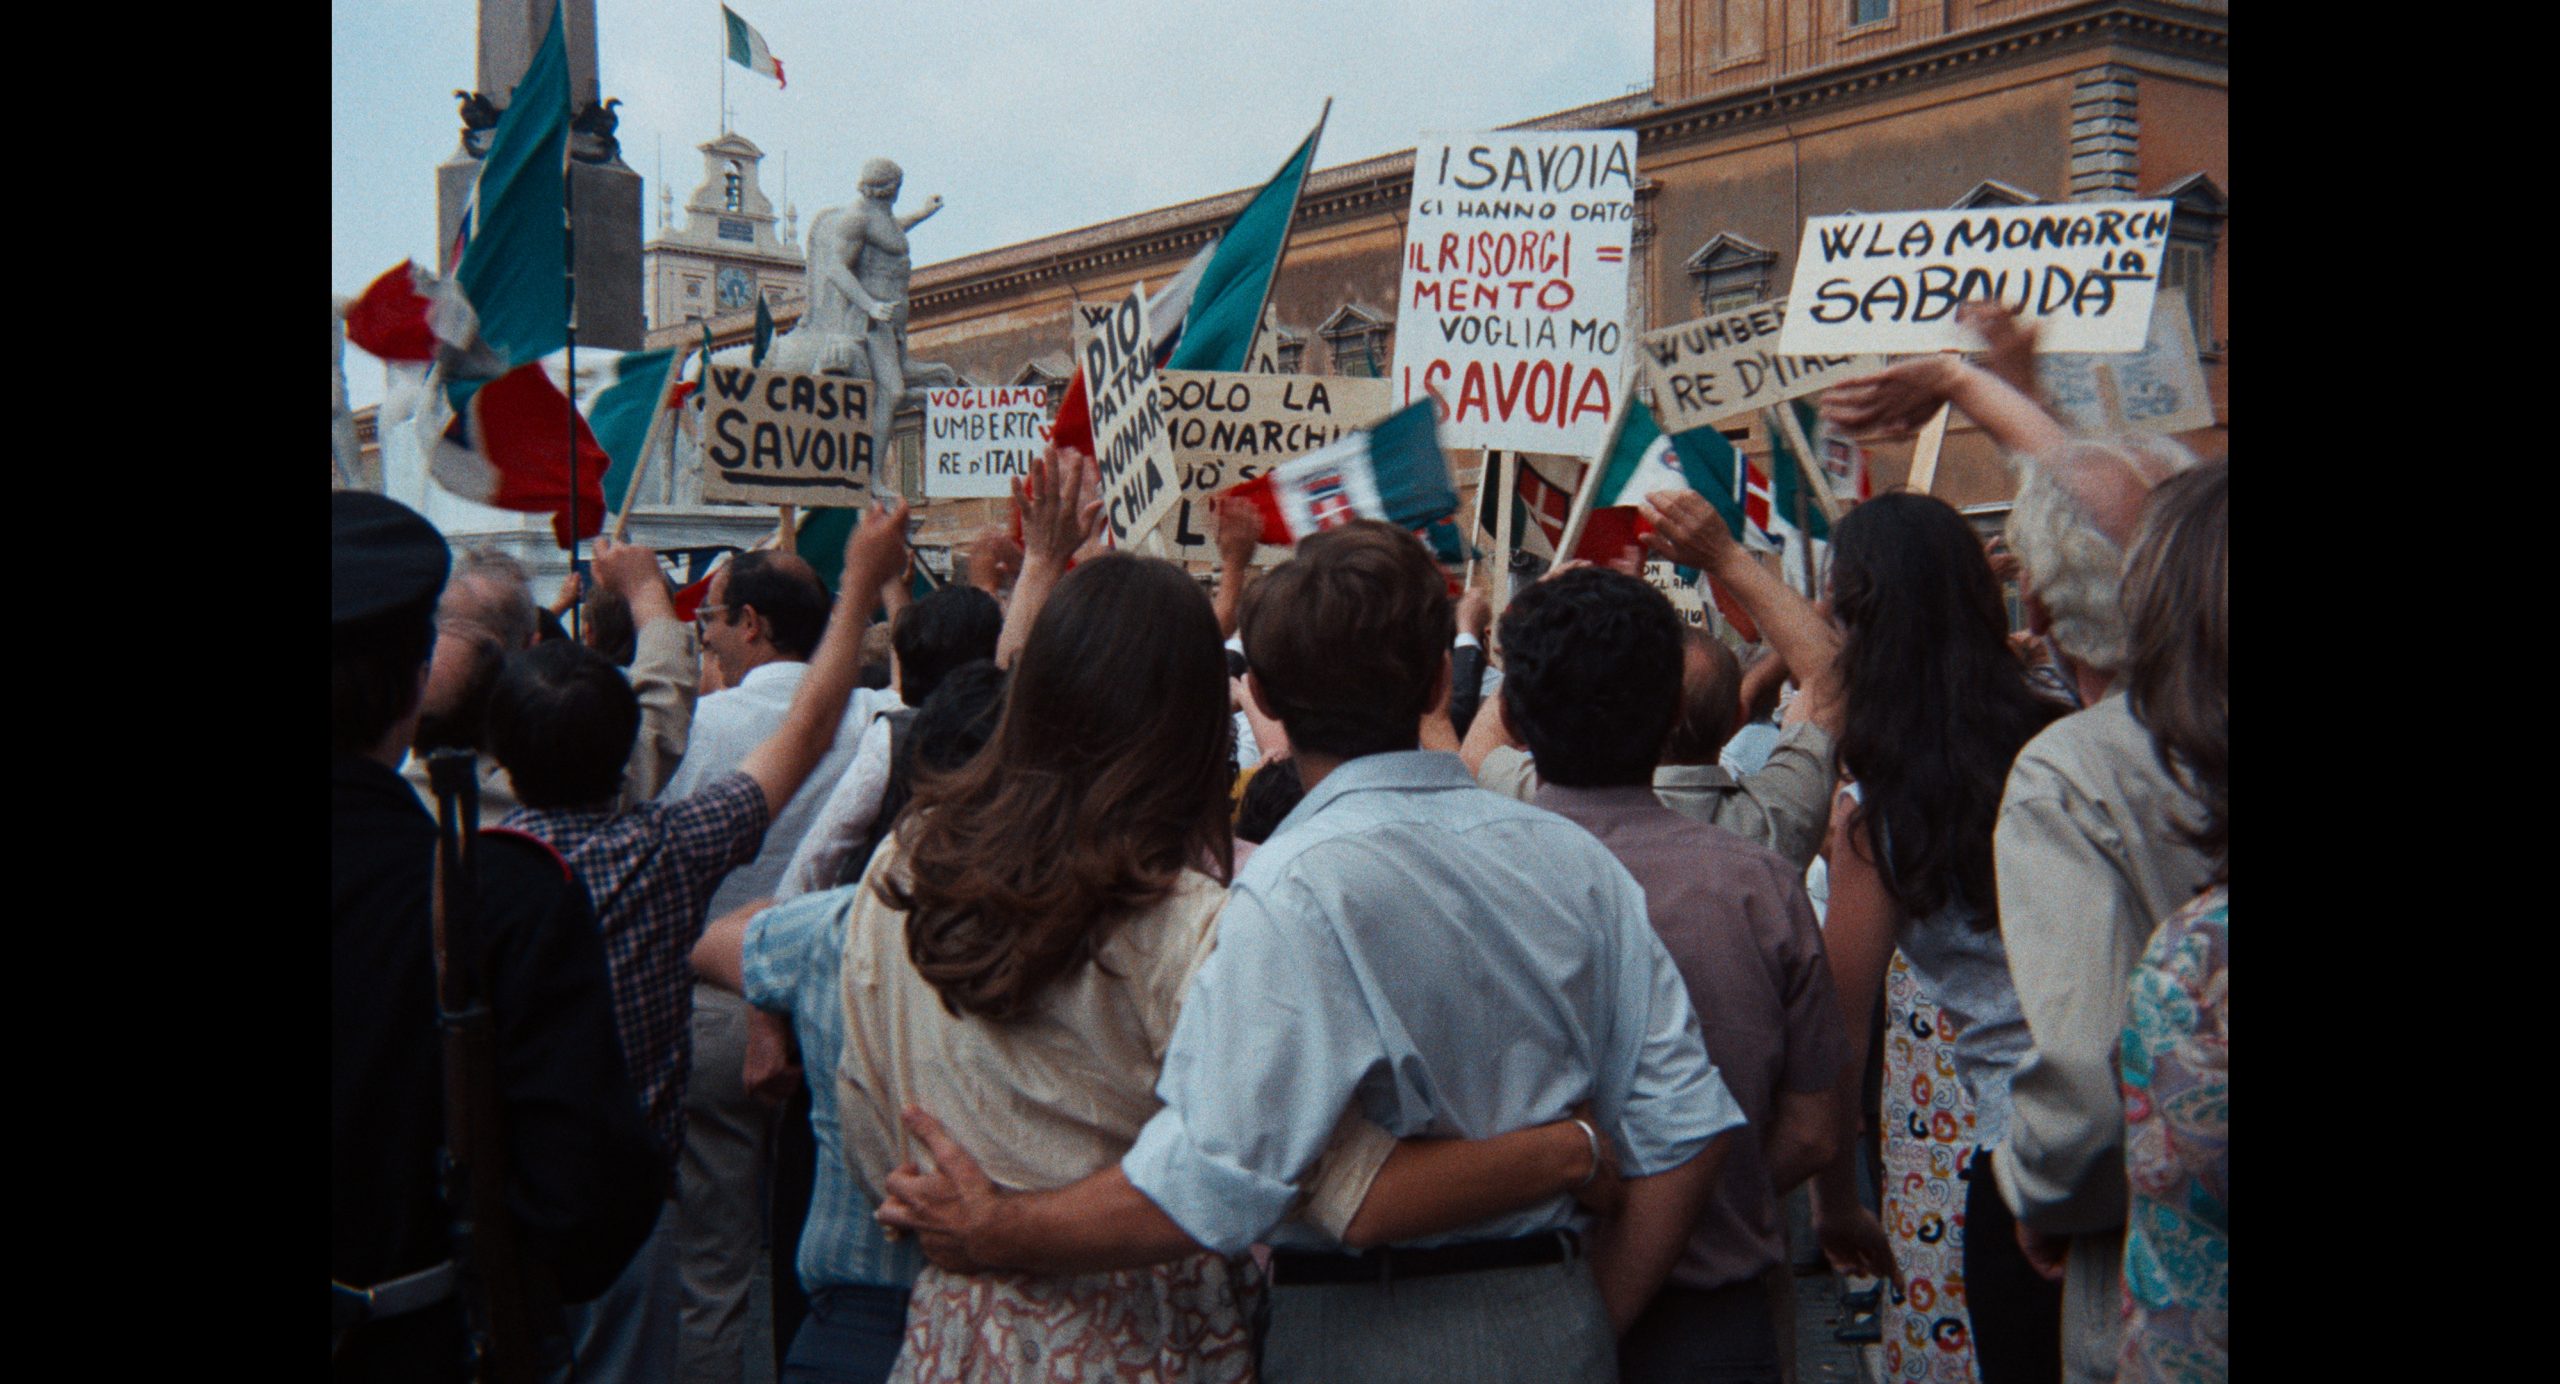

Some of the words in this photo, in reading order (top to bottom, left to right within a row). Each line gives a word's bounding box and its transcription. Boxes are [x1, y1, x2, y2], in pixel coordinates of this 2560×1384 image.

[1439, 146, 1450, 186] I
[1454, 140, 1633, 193] SAVOIA
[1420, 200, 1443, 217] CI
[1458, 201, 1556, 220] HANNO
[1571, 202, 1634, 222] DATO
[1409, 242, 1431, 274] IL
[1438, 231, 1571, 279] RISORGI
[1413, 278, 1574, 313] MENTO
[1087, 292, 1140, 400] DIO
[711, 367, 756, 402] W
[766, 376, 868, 421] CASA
[930, 388, 1048, 410] VOGLIAMO
[1283, 381, 1331, 414] LA
[1424, 359, 1612, 429] SAVOIA
[1670, 373, 1723, 412] RE
[709, 408, 873, 474] SAVOIA
[938, 452, 961, 475] RE
[1110, 456, 1164, 539] CHIA
